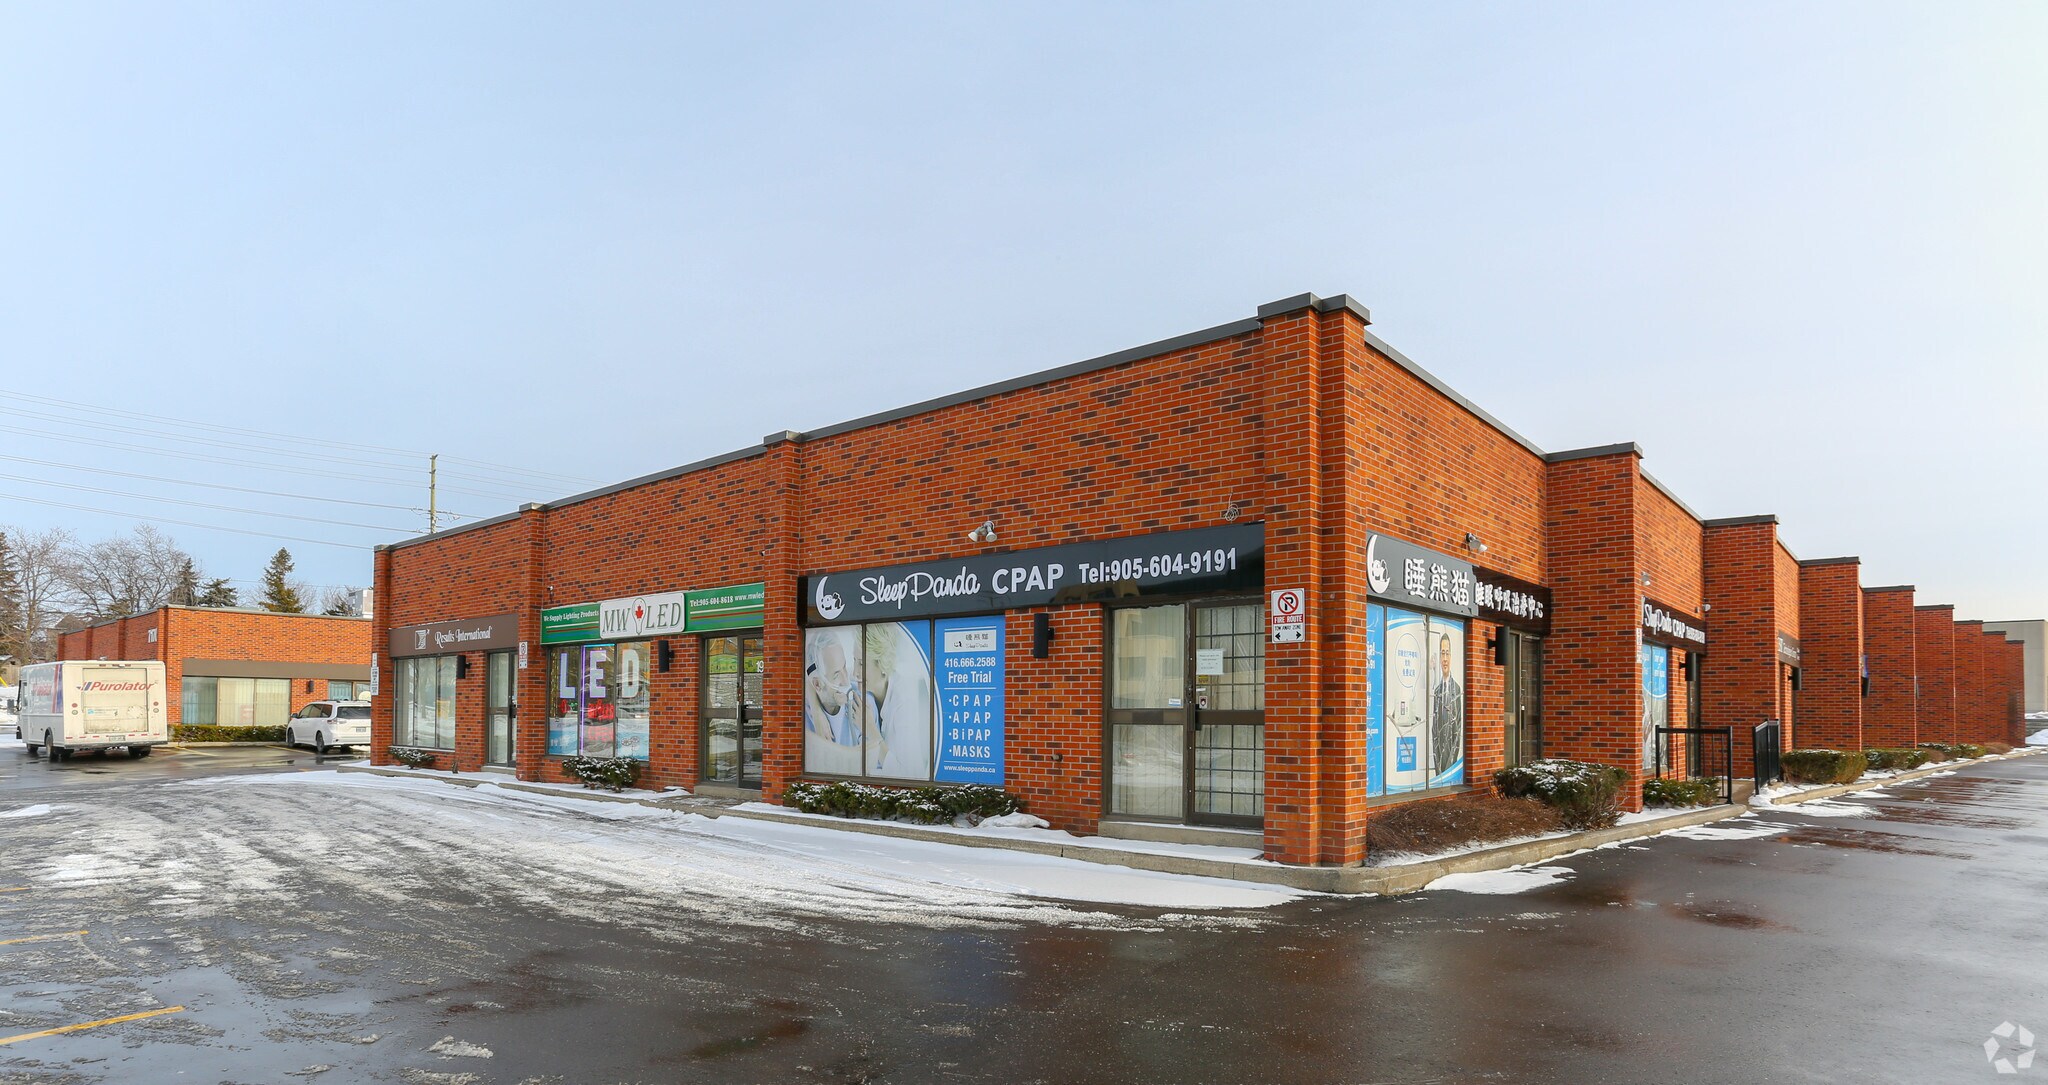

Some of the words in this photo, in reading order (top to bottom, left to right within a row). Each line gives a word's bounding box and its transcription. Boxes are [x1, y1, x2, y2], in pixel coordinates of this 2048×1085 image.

[991, 563, 1064, 595] CPAP
[1078, 547, 1237, 584] Tel:905-604-9191
[1403, 558, 1470, 607] 睡熊猫
[549, 613, 563, 622] Supply
[563, 611, 580, 620] Lighting
[580, 610, 599, 618] Products
[602, 607, 631, 633] MW
[645, 602, 682, 629] LED
[1274, 616, 1285, 624] FIRE
[1287, 614, 1303, 623] ROUTE
[434, 629, 455, 649] Results
[456, 626, 491, 642] International
[944, 657, 996, 668] 416.666.2588
[948, 671, 969, 684] Free
[970, 670, 992, 683] Trial
[90, 681, 155, 691] Purolator
[952, 694, 991, 707] CPAP
[952, 711, 991, 724] APAP
[952, 728, 991, 741] BiPAP
[952, 744, 991, 758] MASKS
[943, 765, 996, 773] www.sleeppanda.ca
